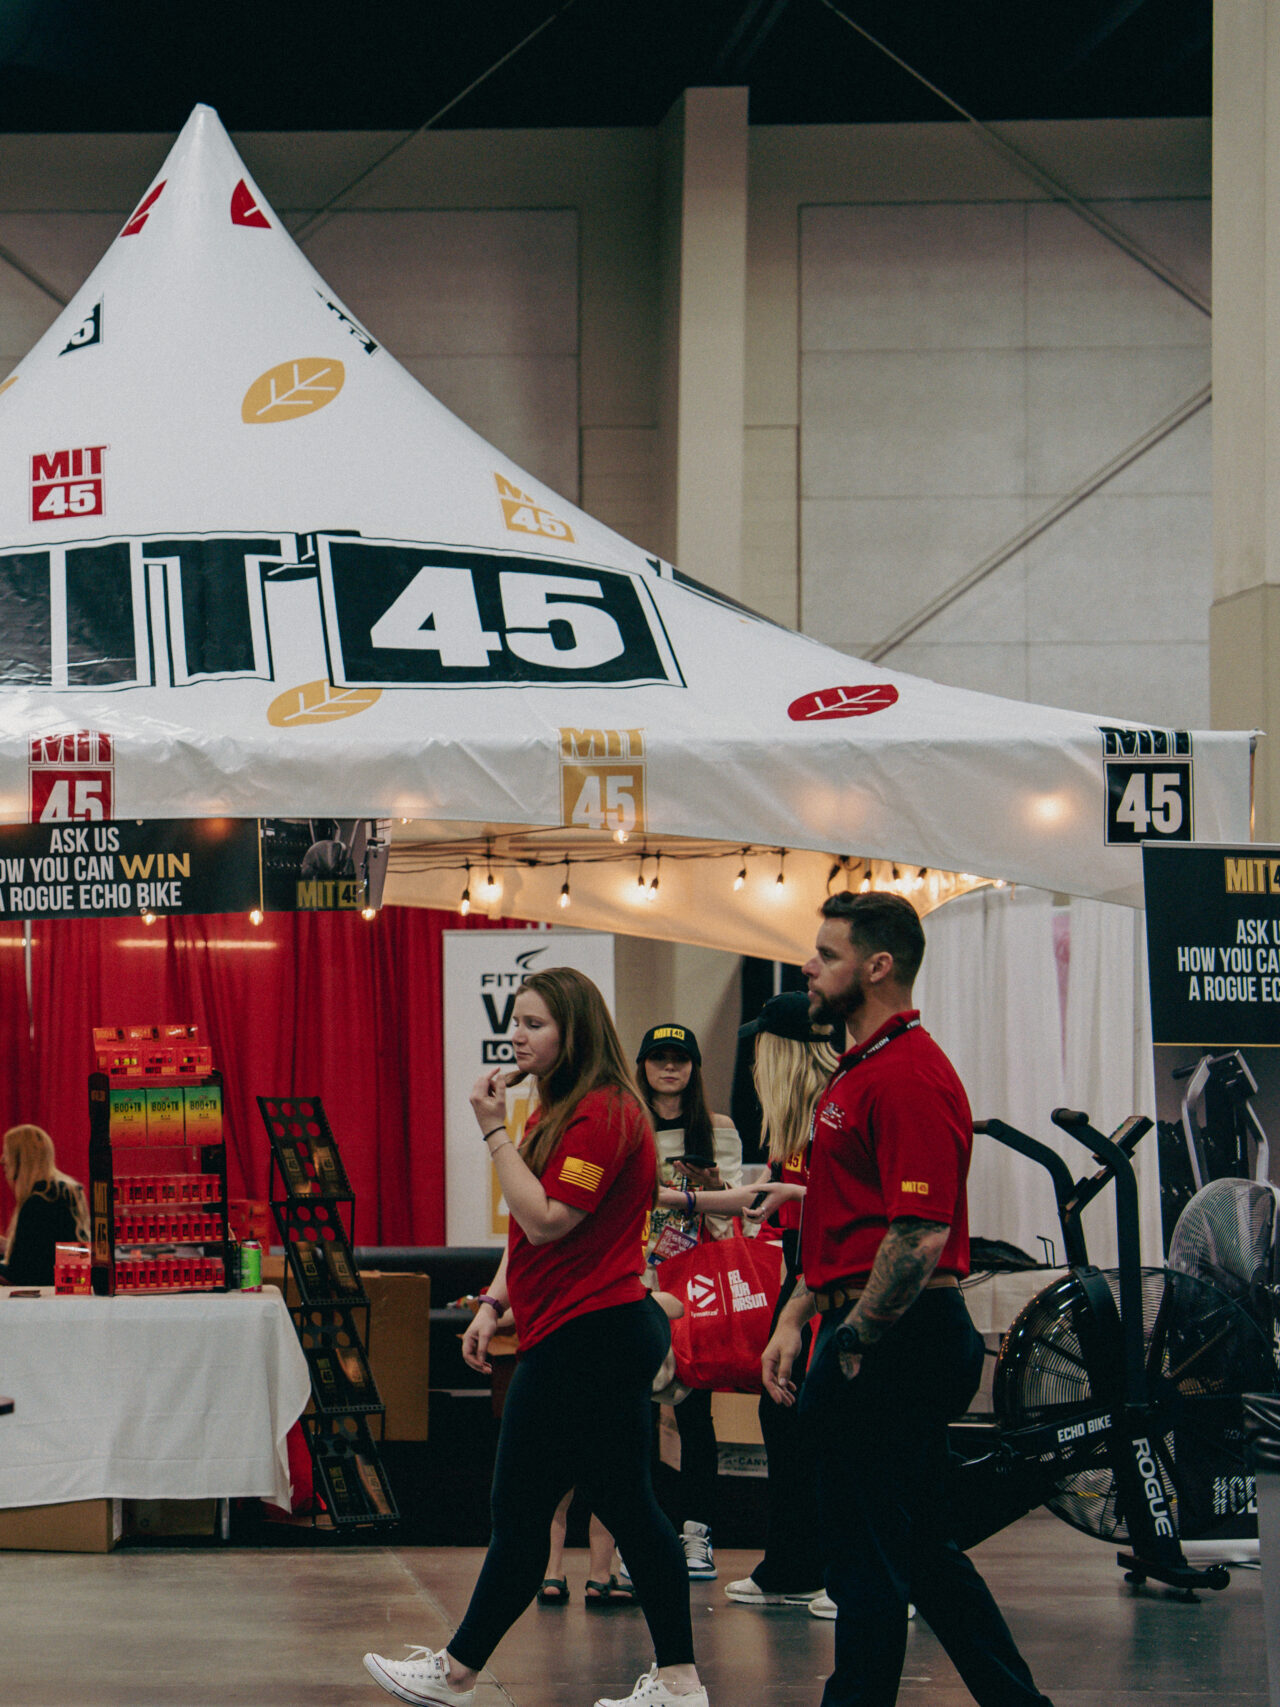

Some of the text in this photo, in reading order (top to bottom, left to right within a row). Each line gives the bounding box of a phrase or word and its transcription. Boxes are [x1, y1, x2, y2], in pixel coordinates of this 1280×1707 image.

[32, 446, 107, 481] MIT
[38, 484, 96, 516] 45
[369, 566, 626, 668] 45
[39, 780, 104, 823] 45
[571, 775, 636, 830] 45
[1116, 773, 1182, 833] 45
[49, 827, 120, 853] ASK US
[30, 857, 69, 882] YOU
[74, 855, 114, 881] CAN
[119, 853, 191, 879] WIN
[1225, 858, 1267, 892] MIT
[10, 885, 75, 911] ROGUE
[79, 883, 131, 909] ECHO
[137, 881, 182, 907] BIKE
[297, 881, 336, 908] MIT
[1236, 919, 1269, 945] ASK
[1177, 946, 1216, 973] HOW
[1219, 947, 1252, 973] YOU
[1188, 975, 1201, 1001] A
[1204, 976, 1258, 1002] ROGUE
[1056, 1414, 1113, 1443] ECHO BIKE
[1131, 1436, 1174, 1539] ROGUE
